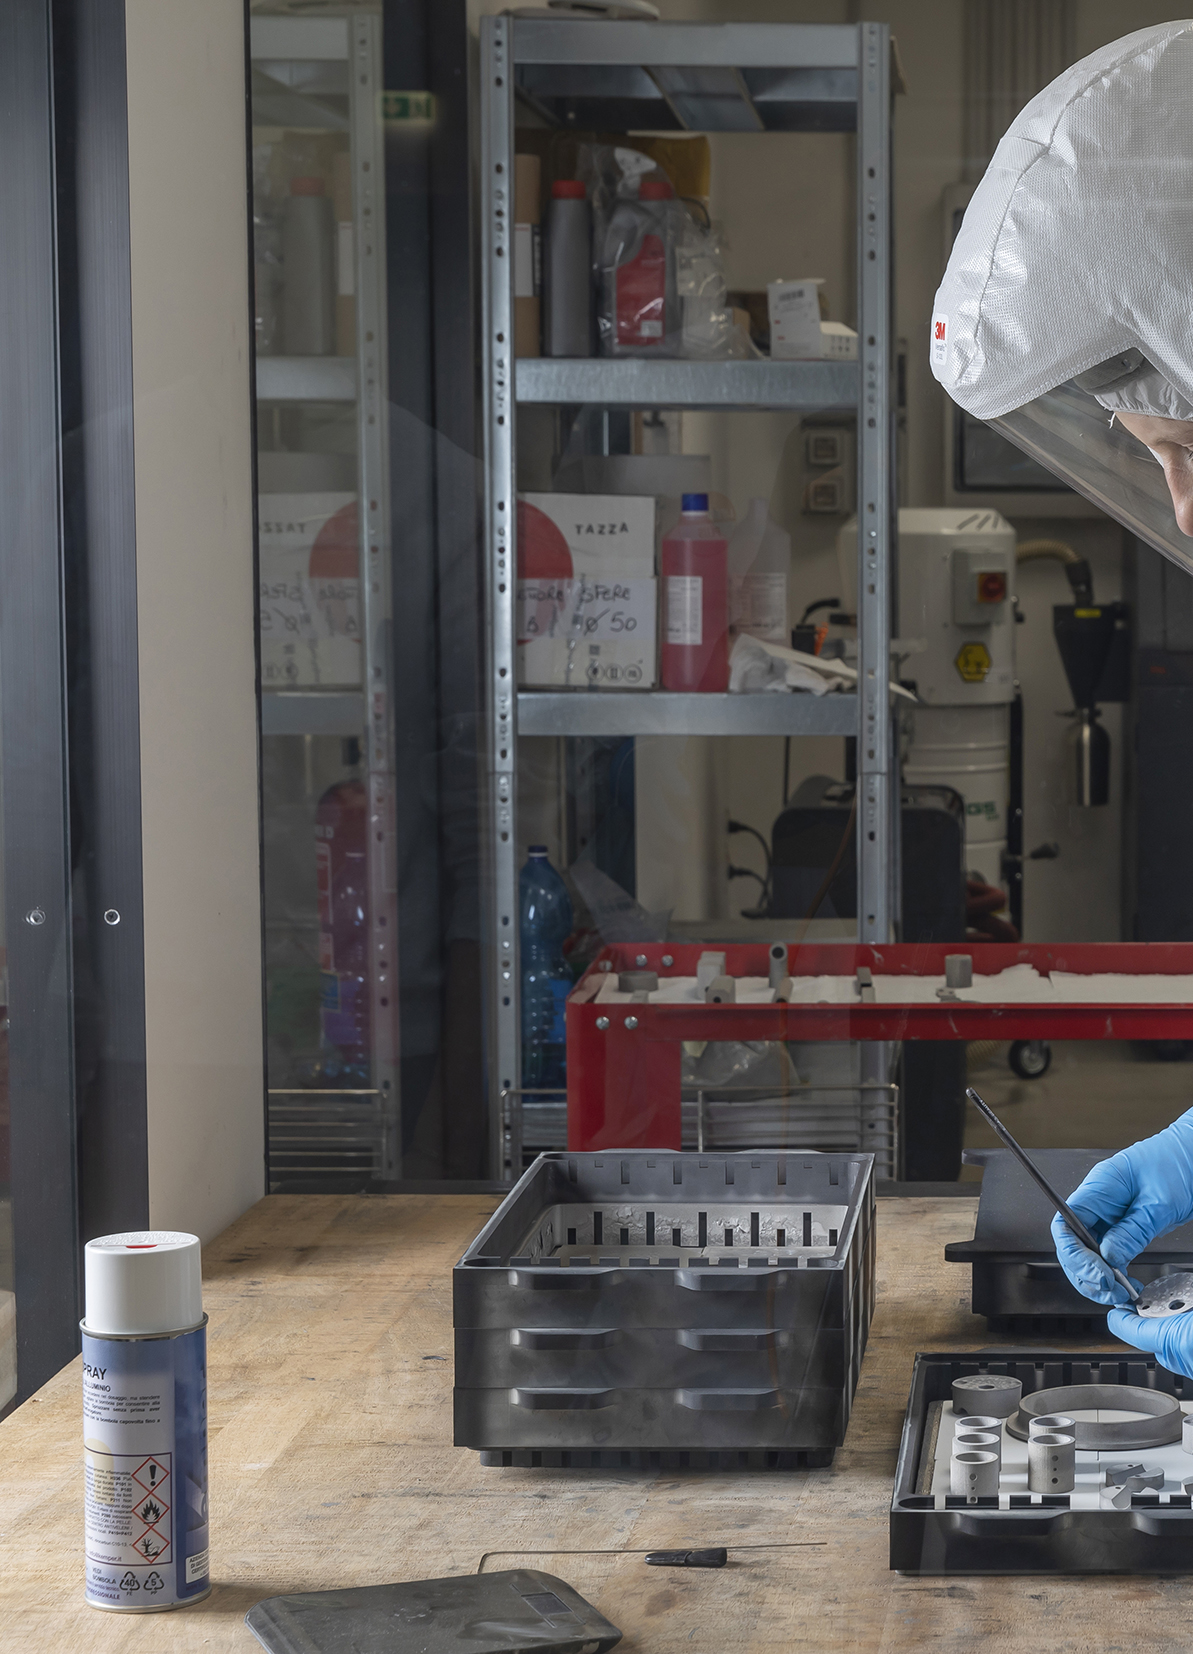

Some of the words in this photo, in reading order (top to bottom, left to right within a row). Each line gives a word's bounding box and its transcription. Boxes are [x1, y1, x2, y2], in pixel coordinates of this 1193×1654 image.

[935, 321, 946, 341] 3M
[575, 522, 630, 535] TAZZA
[610, 611, 637, 633] 50
[84, 1363, 107, 1380] PRAY
[124, 1578, 136, 1587] 40
[151, 1578, 157, 1586] 5
